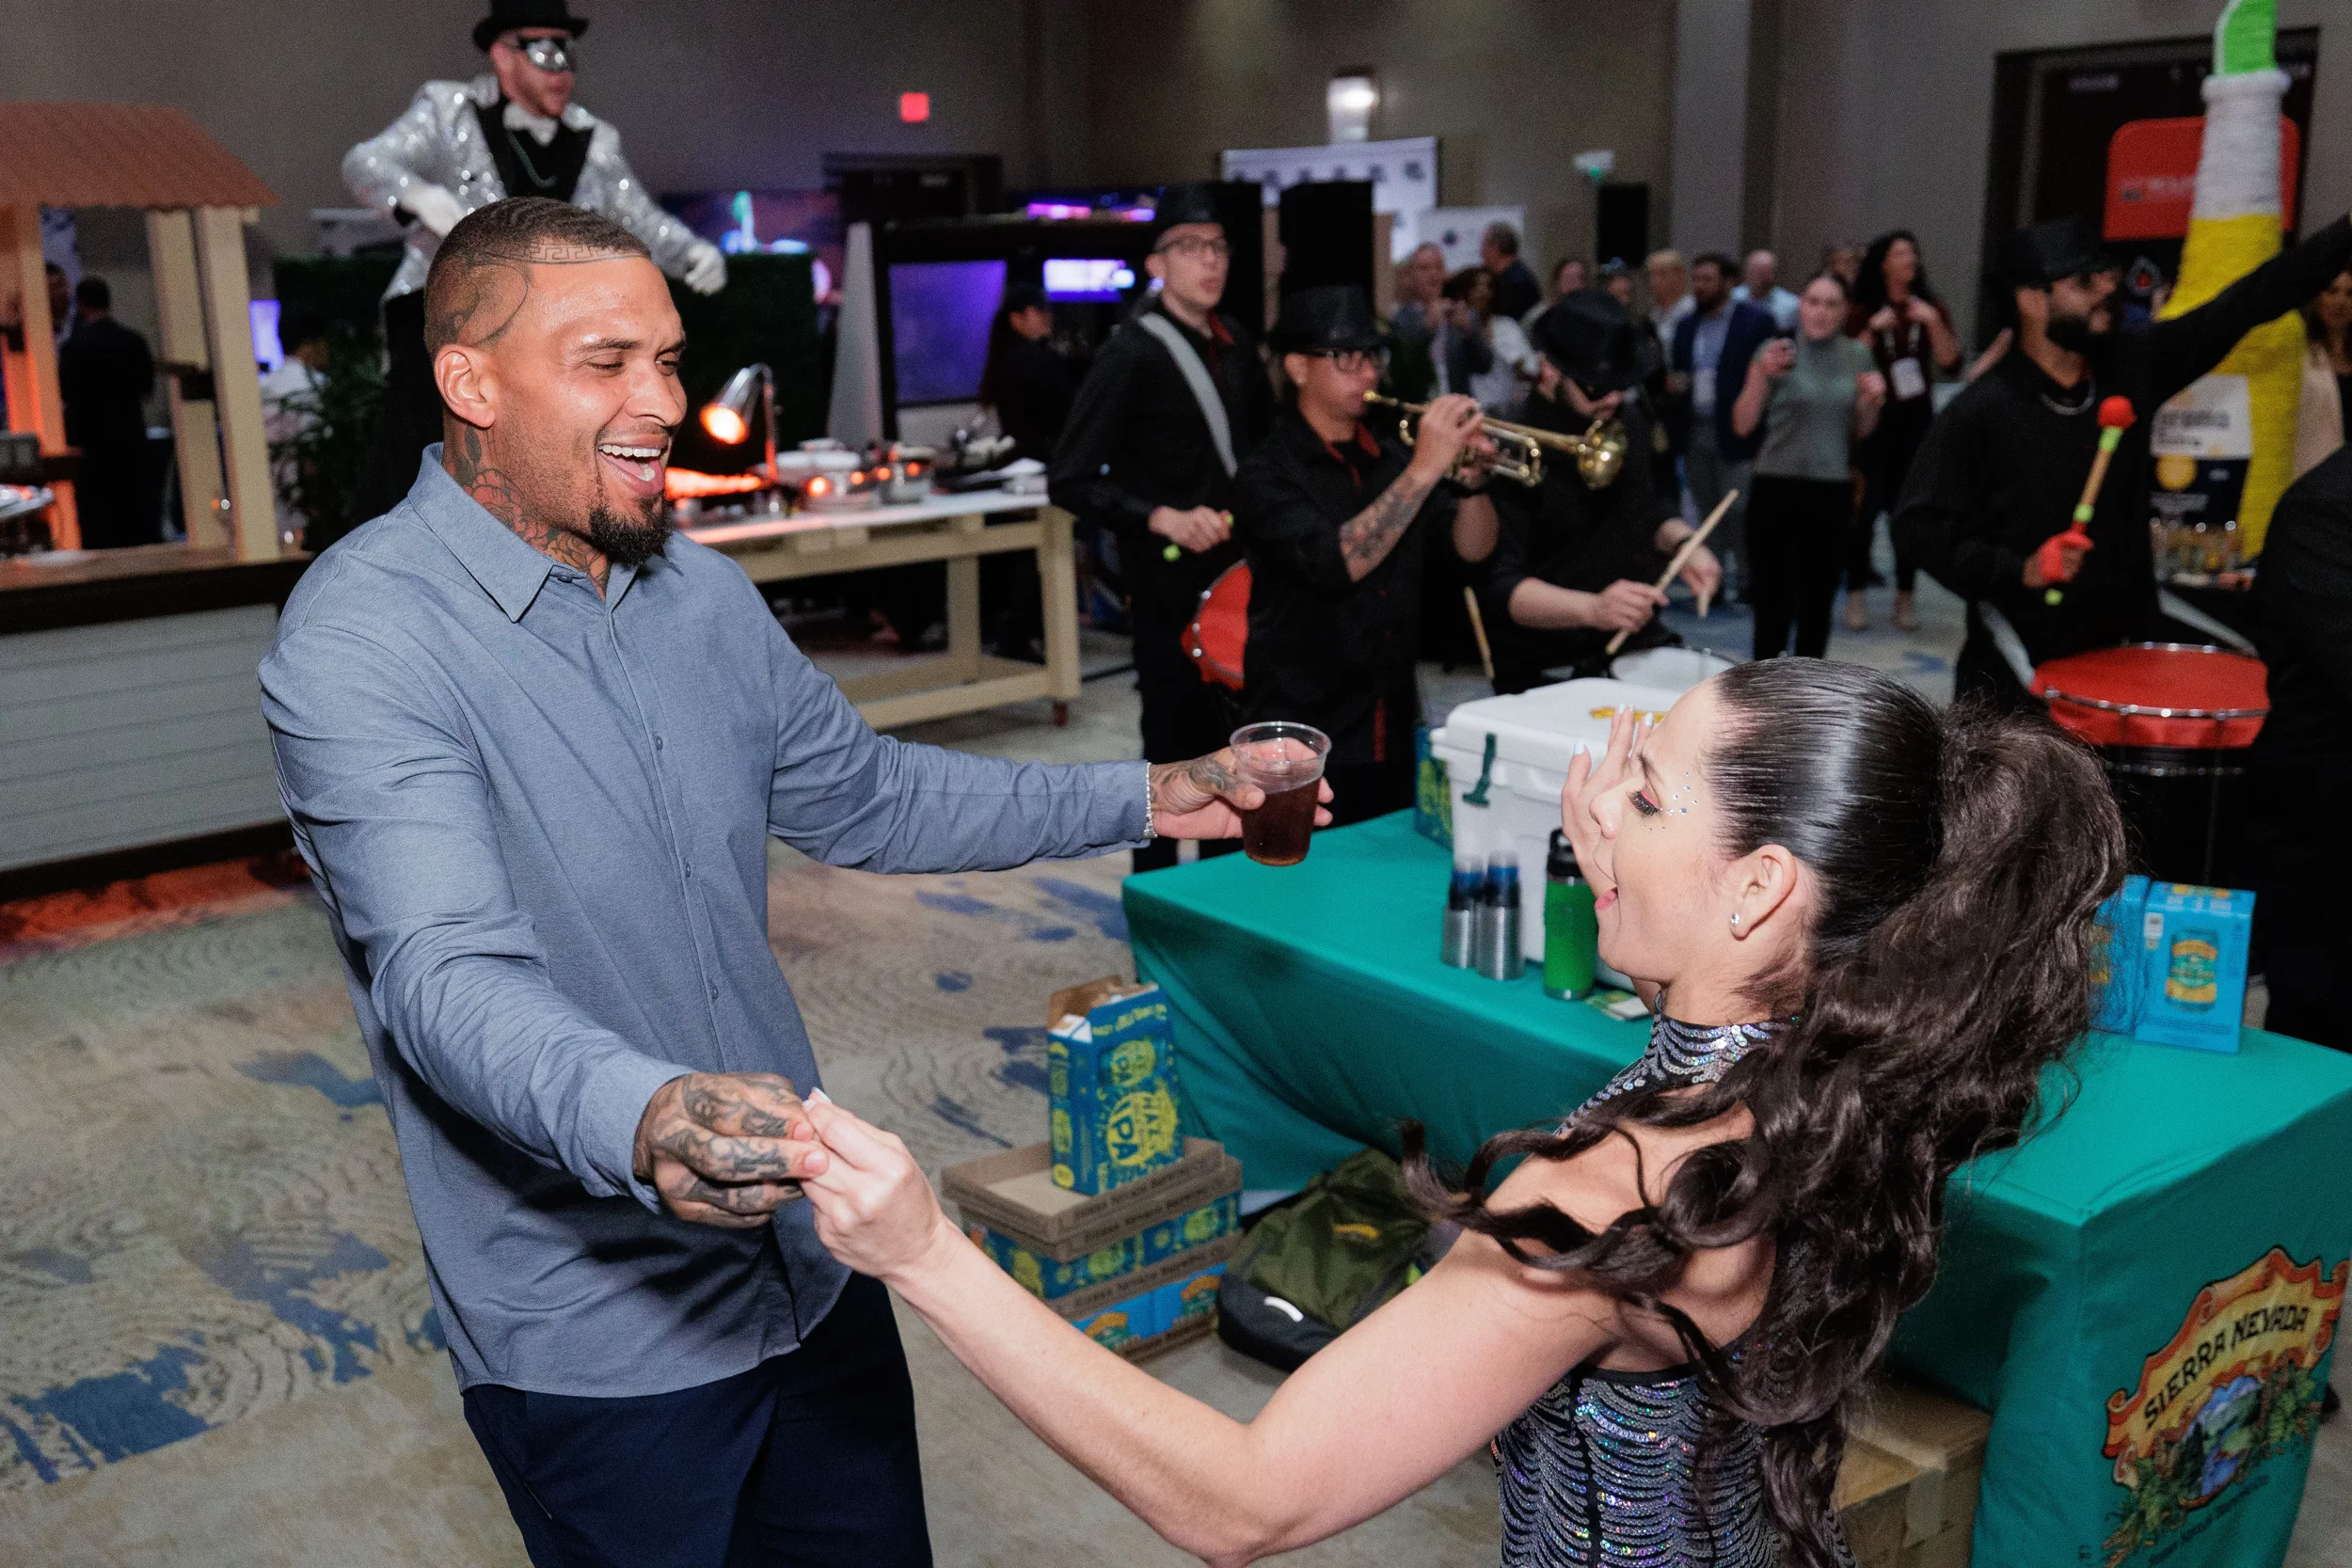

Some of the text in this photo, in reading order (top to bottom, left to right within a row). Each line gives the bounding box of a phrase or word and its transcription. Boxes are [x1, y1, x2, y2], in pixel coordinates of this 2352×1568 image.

[1112, 1101, 1137, 1160] IPA
[2143, 1304, 2310, 1430] SIERRA NEVADA
